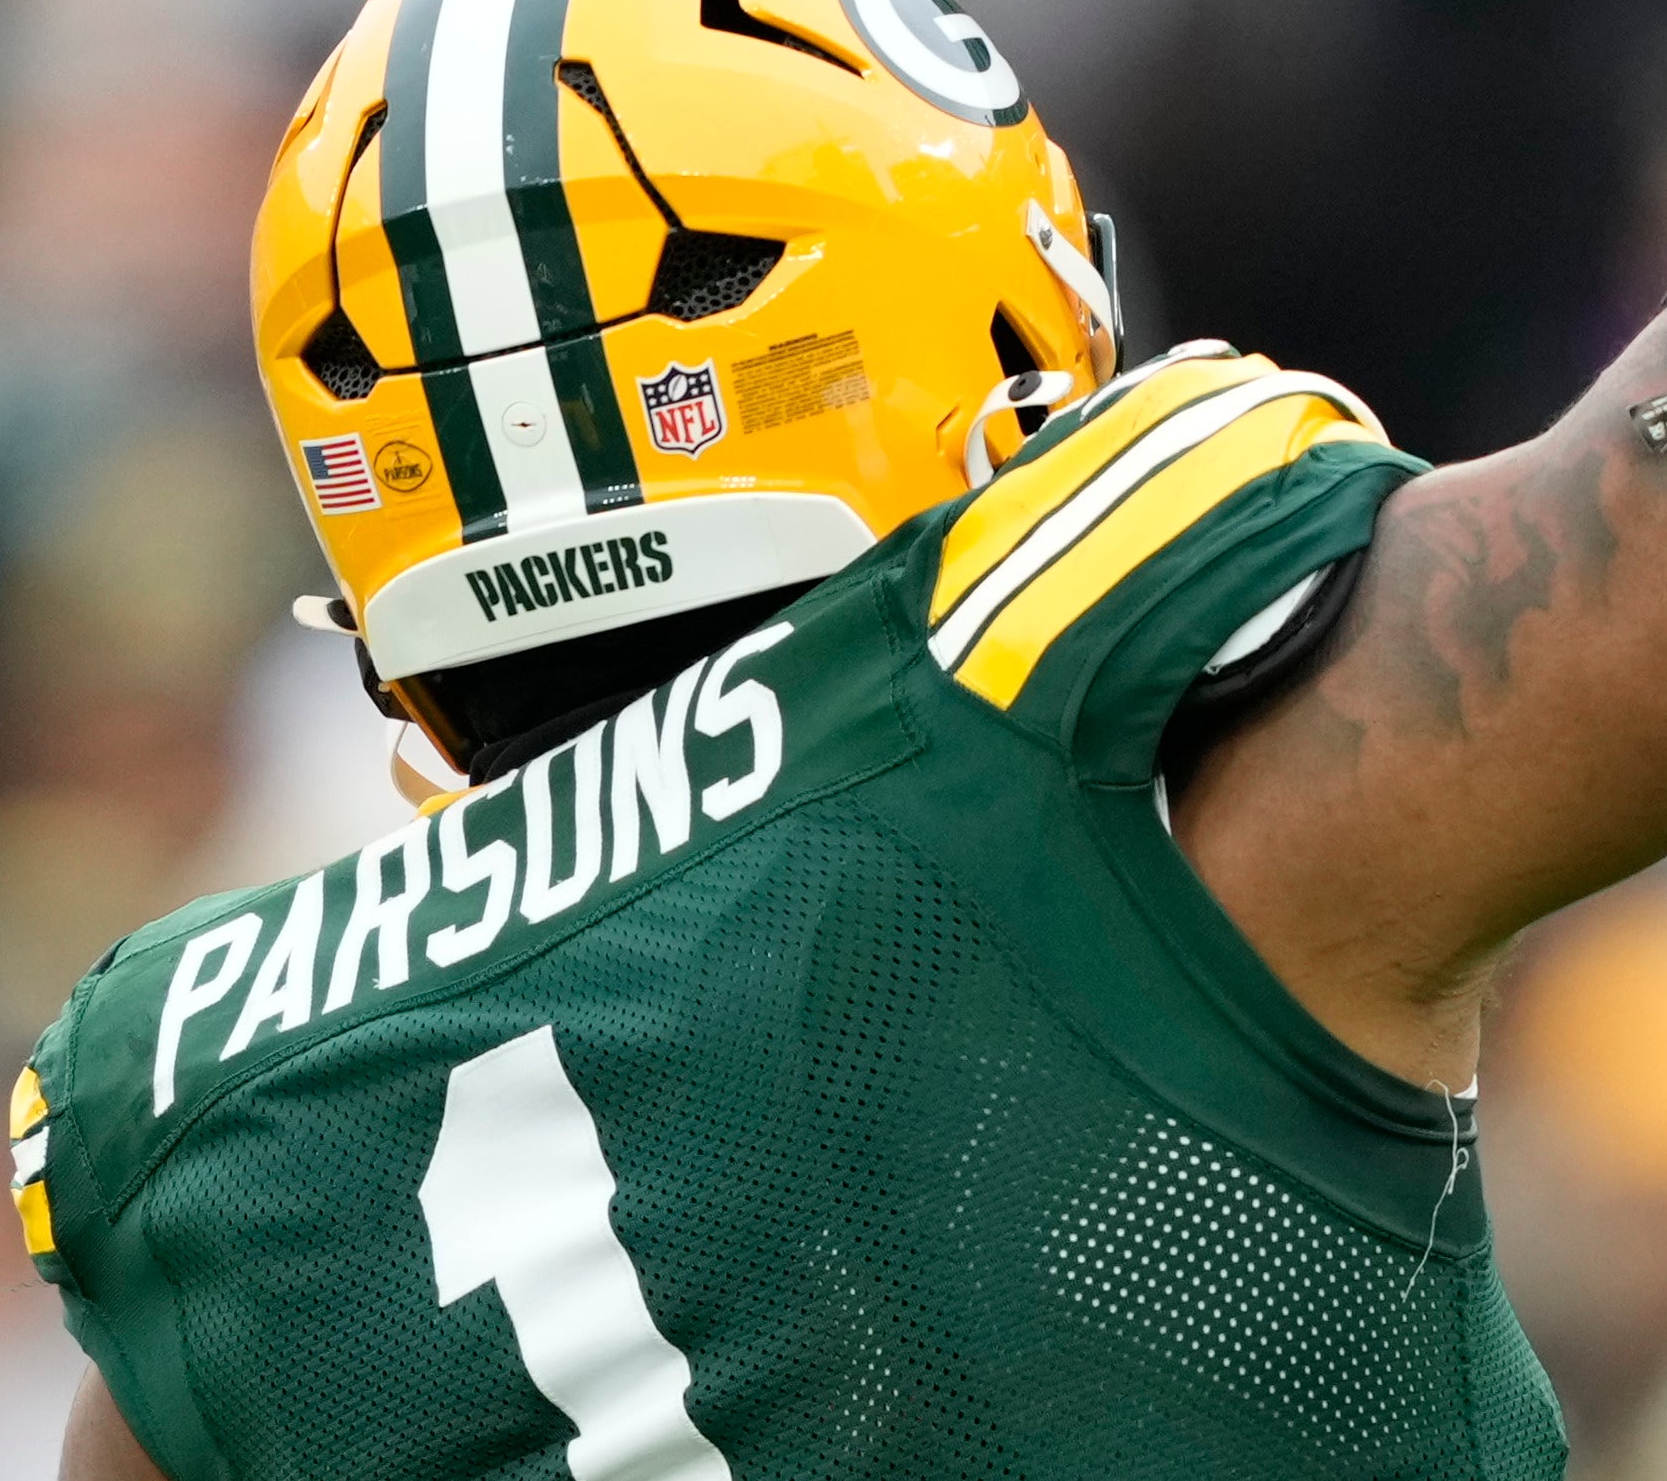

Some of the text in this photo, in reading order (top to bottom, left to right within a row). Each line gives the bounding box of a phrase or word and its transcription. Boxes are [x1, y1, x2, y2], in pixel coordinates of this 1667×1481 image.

[655, 401, 716, 444] NFL
[465, 531, 674, 623] PACKERS
[153, 622, 795, 1118] PARSONS
